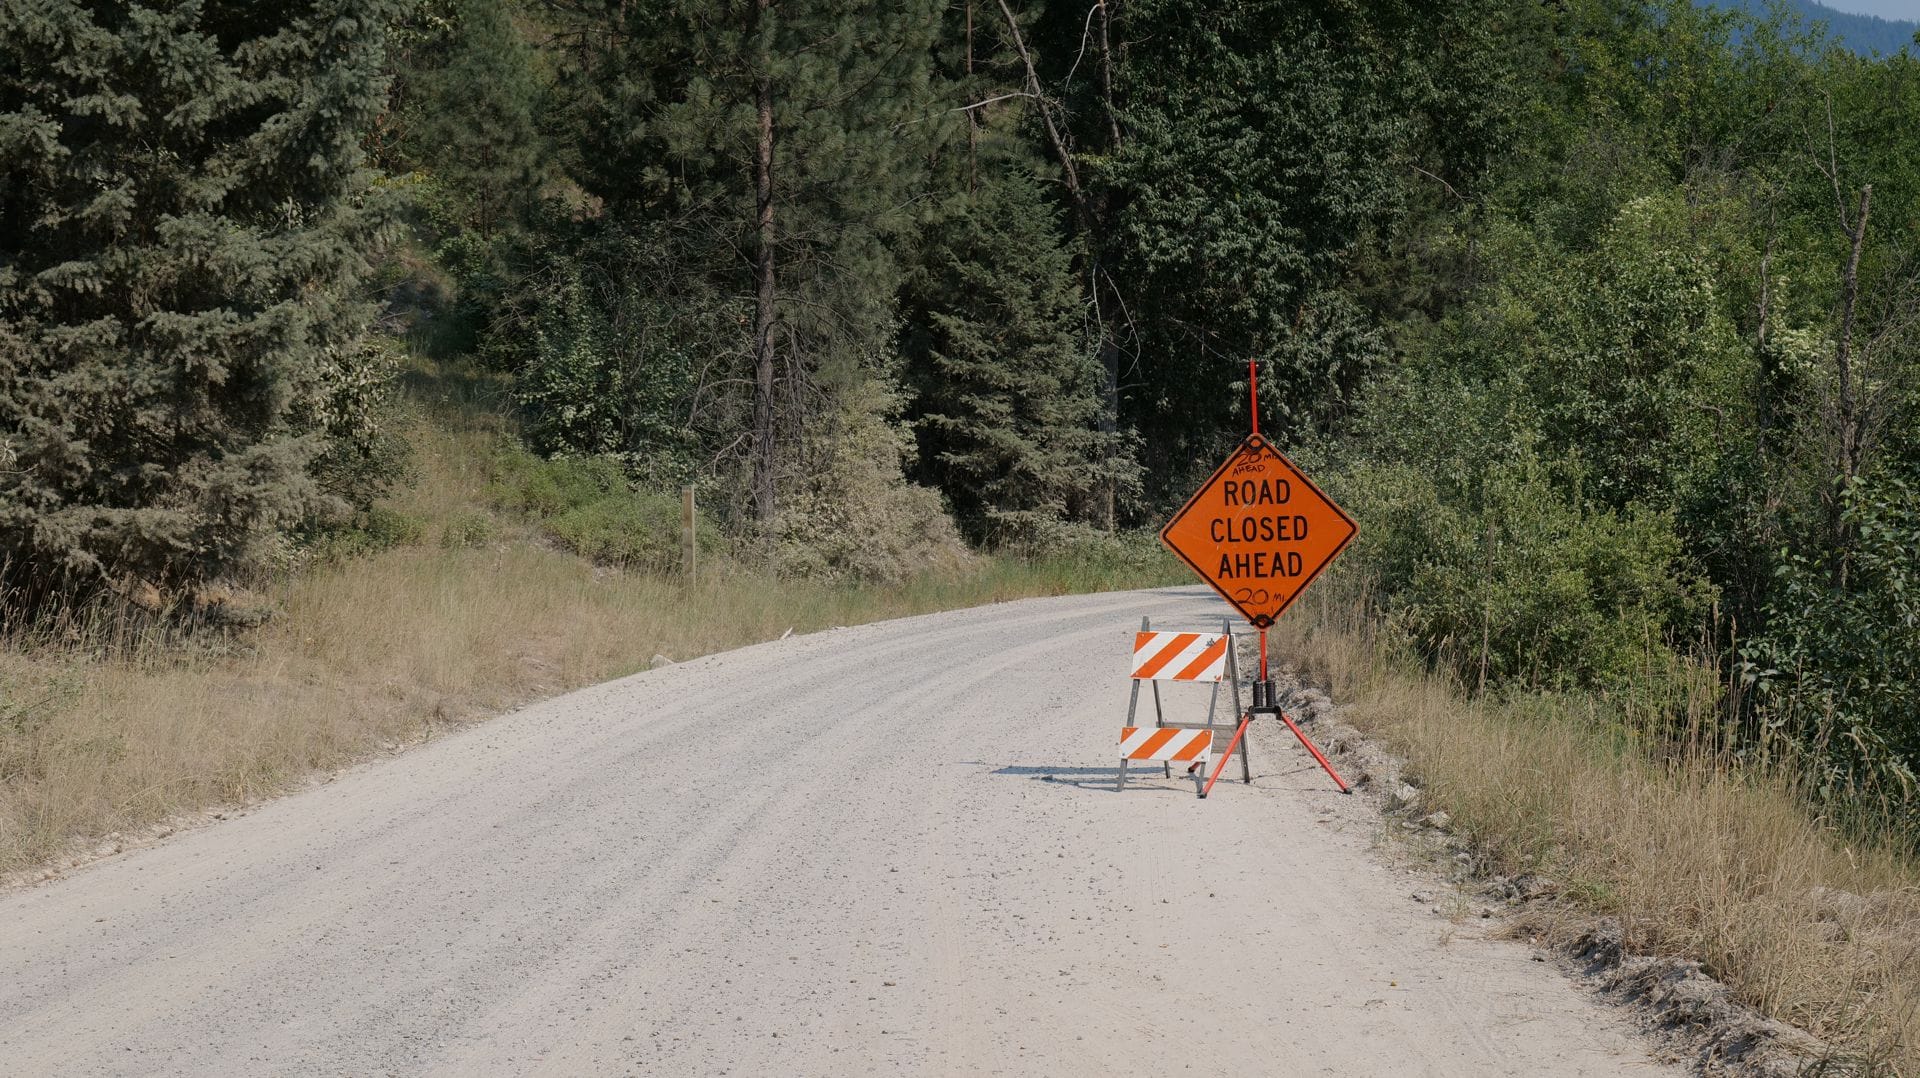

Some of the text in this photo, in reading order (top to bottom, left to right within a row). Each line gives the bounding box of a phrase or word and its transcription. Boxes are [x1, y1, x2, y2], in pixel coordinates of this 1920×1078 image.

[1232, 464, 1265, 477] AHEAD
[1237, 453, 1262, 466] 20
[1224, 479, 1291, 506] ROAD
[1211, 515, 1308, 543] CLOSED
[1218, 552, 1303, 579] AHEAD
[1235, 587, 1269, 606] 20
